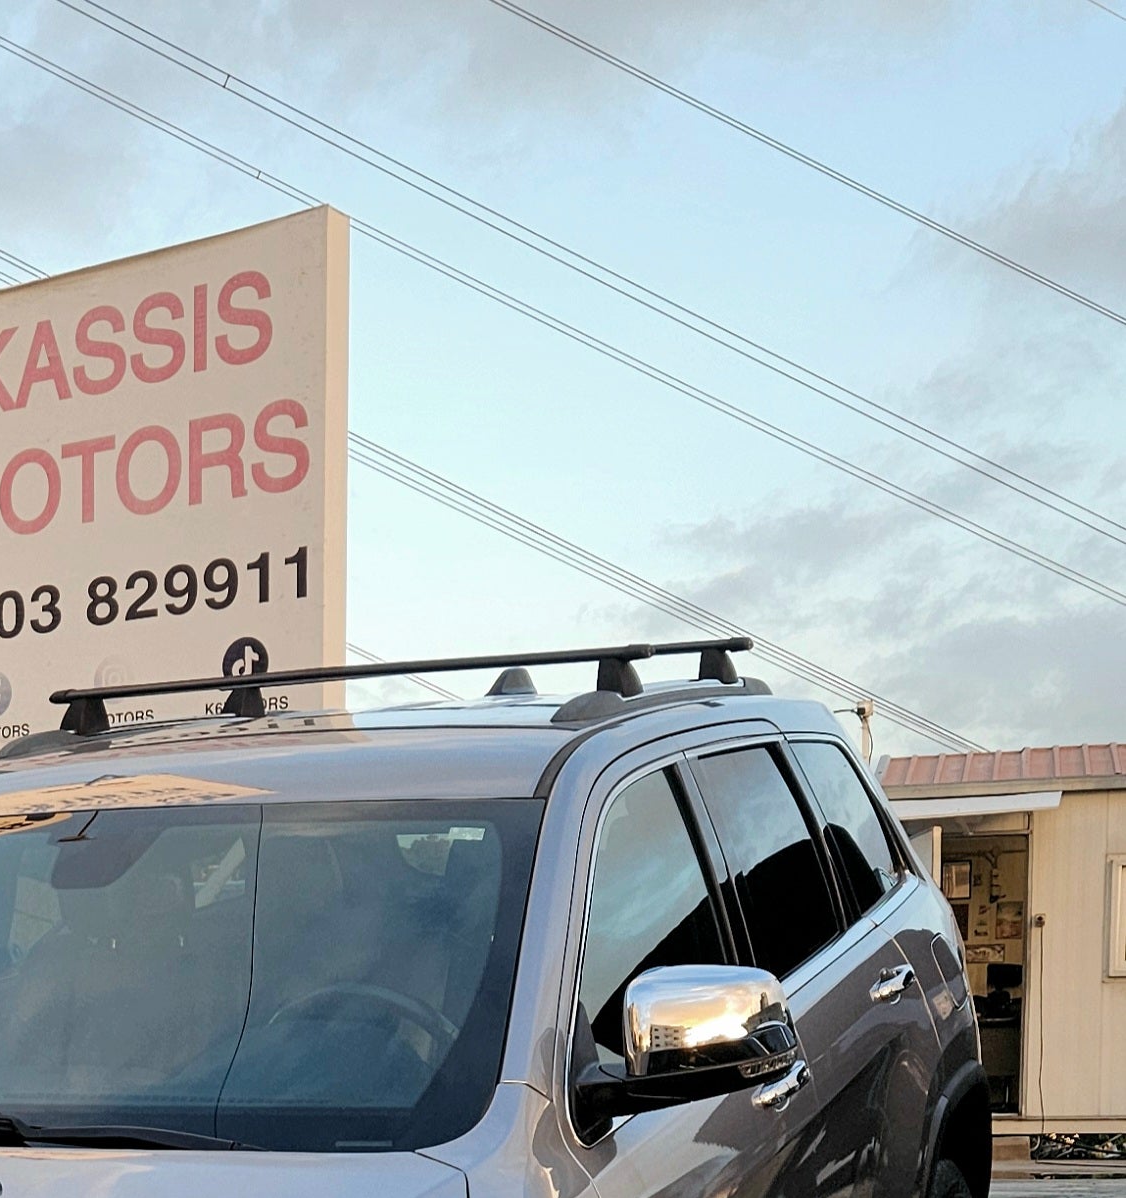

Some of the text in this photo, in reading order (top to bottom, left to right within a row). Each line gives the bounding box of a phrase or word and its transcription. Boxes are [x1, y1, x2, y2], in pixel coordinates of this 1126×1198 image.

[86, 546, 309, 627] 829911
[205, 696, 290, 717] K6ORS
[106, 709, 155, 726] OTORS
